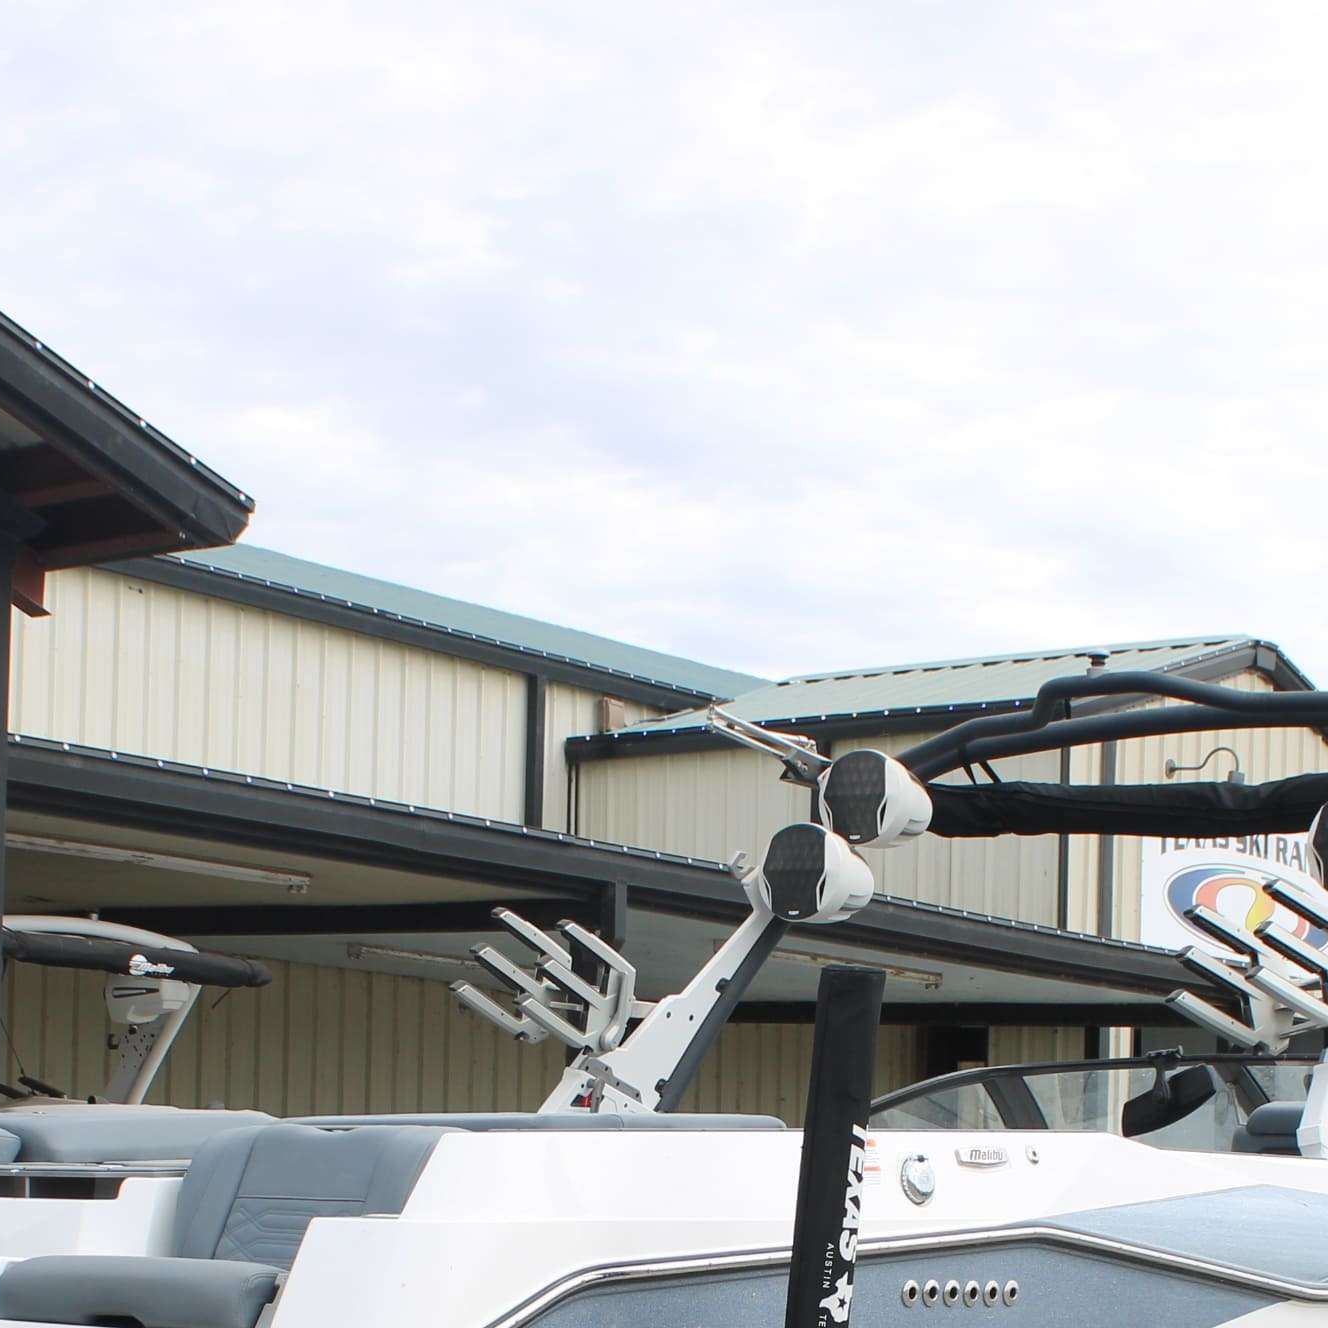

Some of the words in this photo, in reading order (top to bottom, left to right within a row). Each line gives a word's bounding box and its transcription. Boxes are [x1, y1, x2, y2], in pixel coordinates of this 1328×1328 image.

[969, 1149, 1004, 1161] Malibu
[839, 1124, 869, 1264] TEXAS
[823, 1242, 835, 1289] AUSTIN
